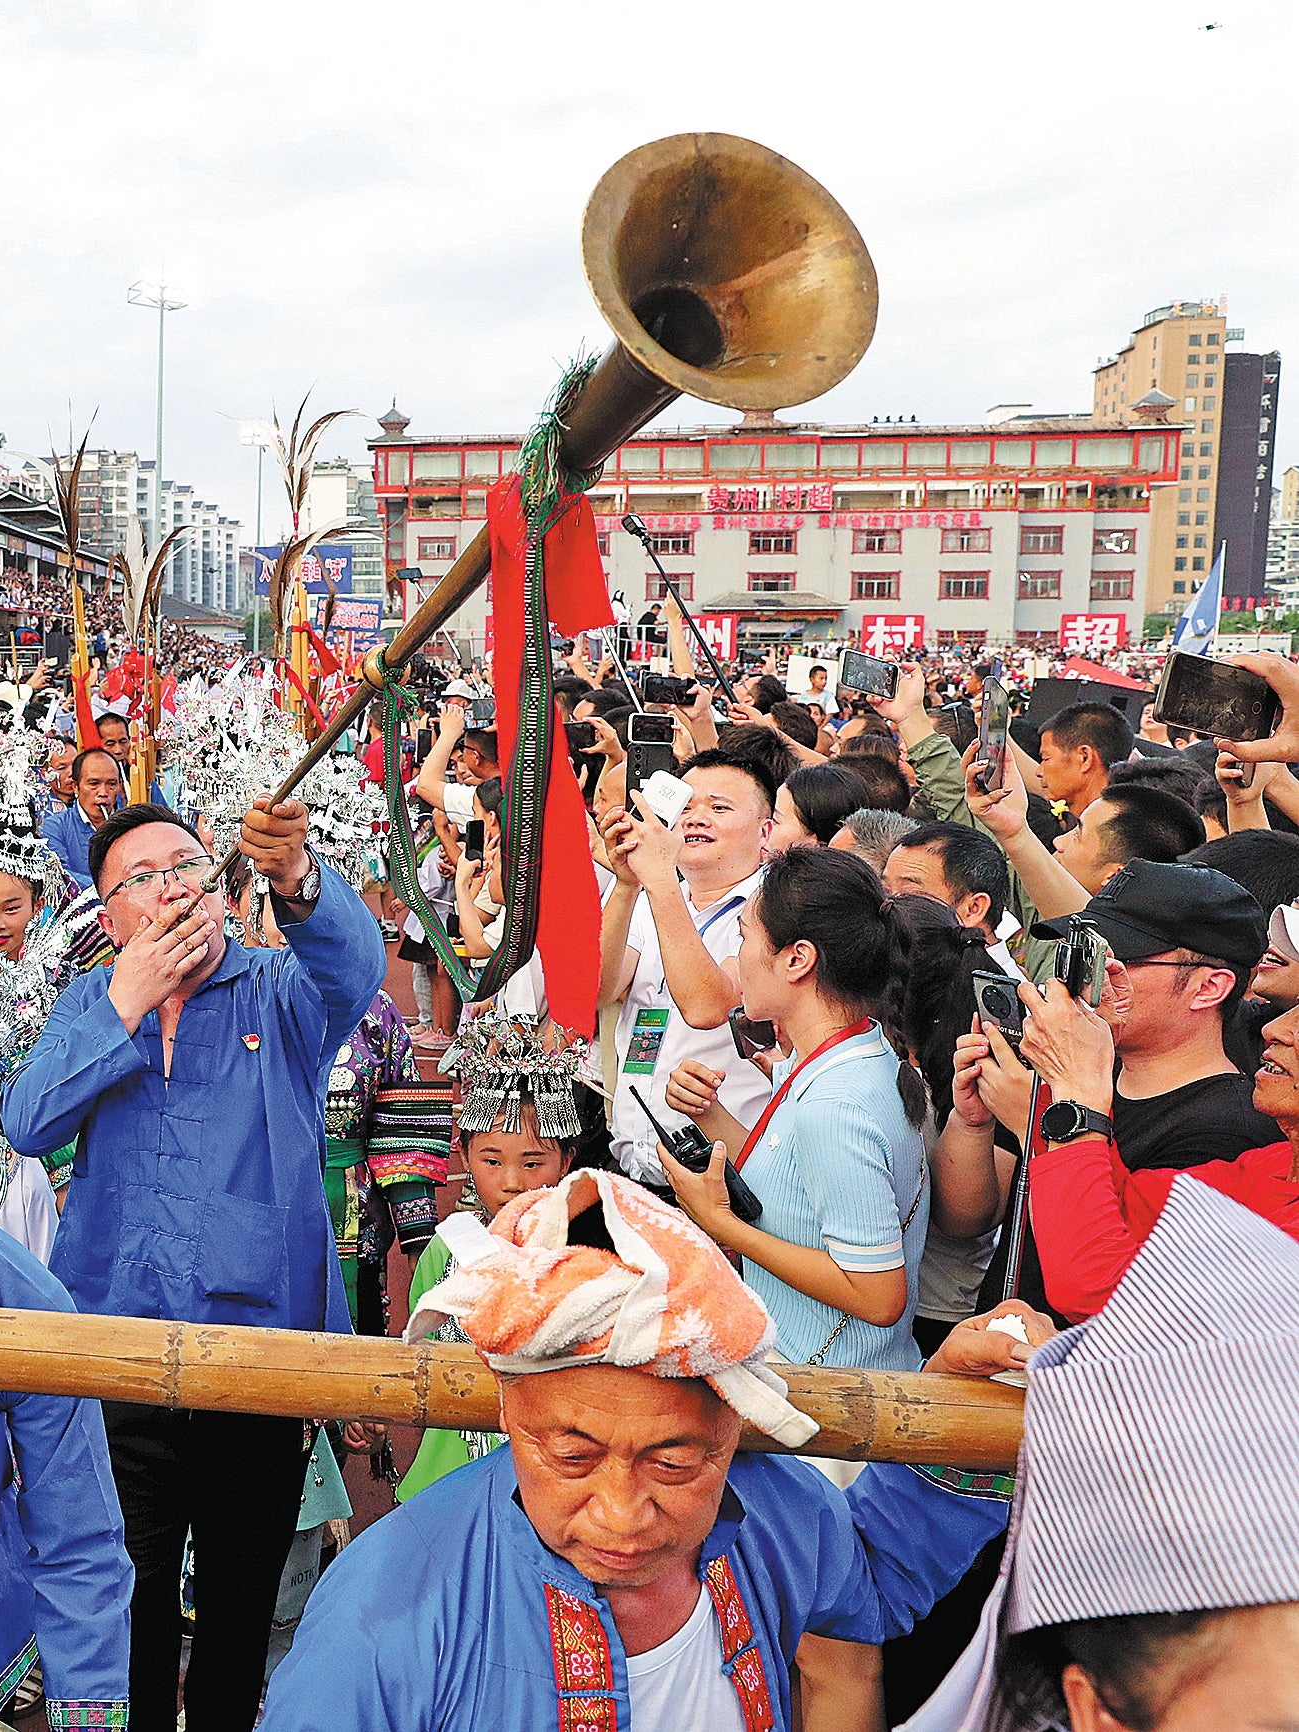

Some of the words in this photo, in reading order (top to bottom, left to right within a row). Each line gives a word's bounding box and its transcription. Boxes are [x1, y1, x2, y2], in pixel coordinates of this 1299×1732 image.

[707, 486, 758, 512] 贵州
[777, 484, 833, 512] 村超
[865, 616, 921, 657] 村
[1063, 615, 1119, 653] 超
